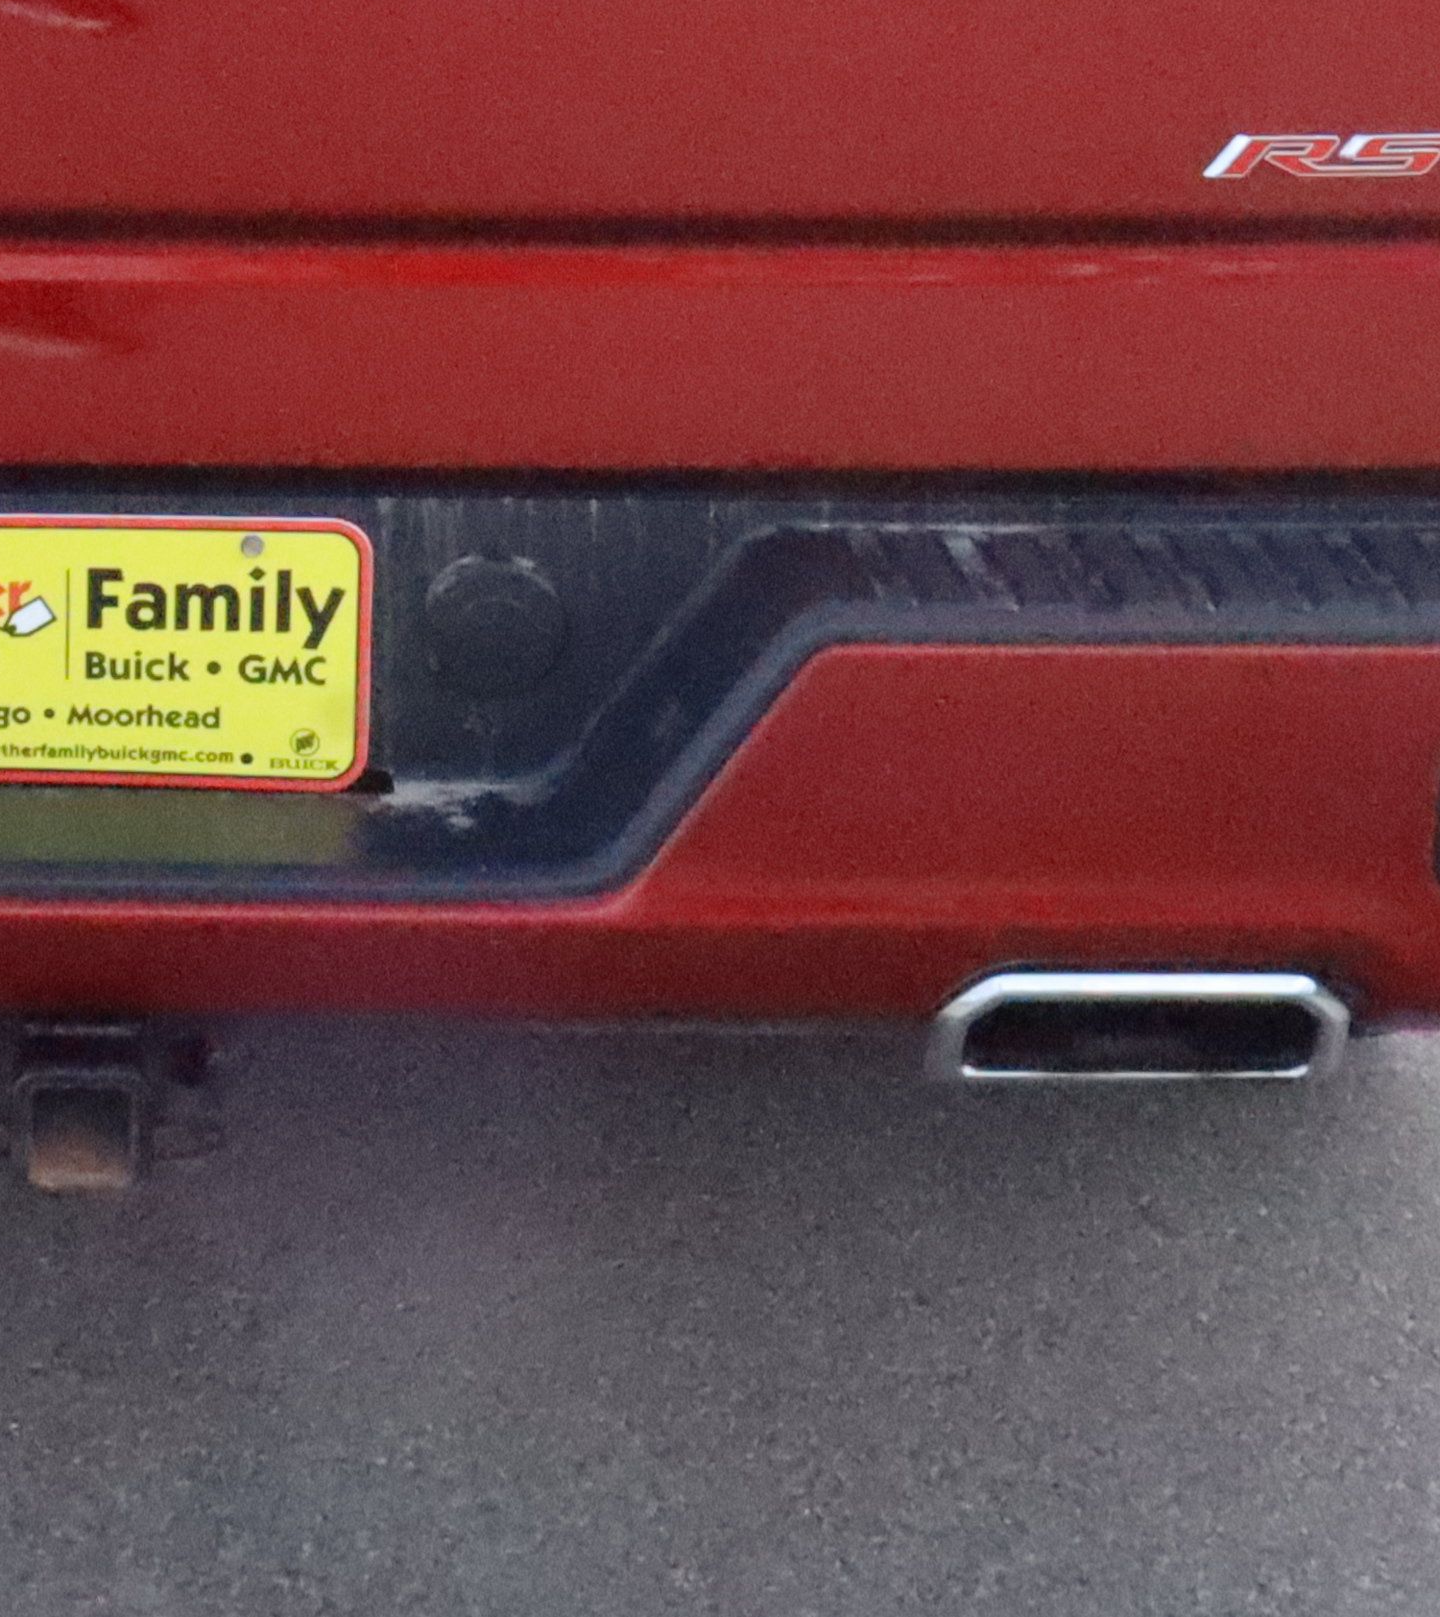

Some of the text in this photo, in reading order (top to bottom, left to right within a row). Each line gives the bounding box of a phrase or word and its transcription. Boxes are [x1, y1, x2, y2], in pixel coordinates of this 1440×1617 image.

[85, 566, 346, 649] Family
[84, 651, 327, 685] Buick GMC
[67, 704, 221, 729] Moorhead
[269, 757, 340, 770] BUICK
